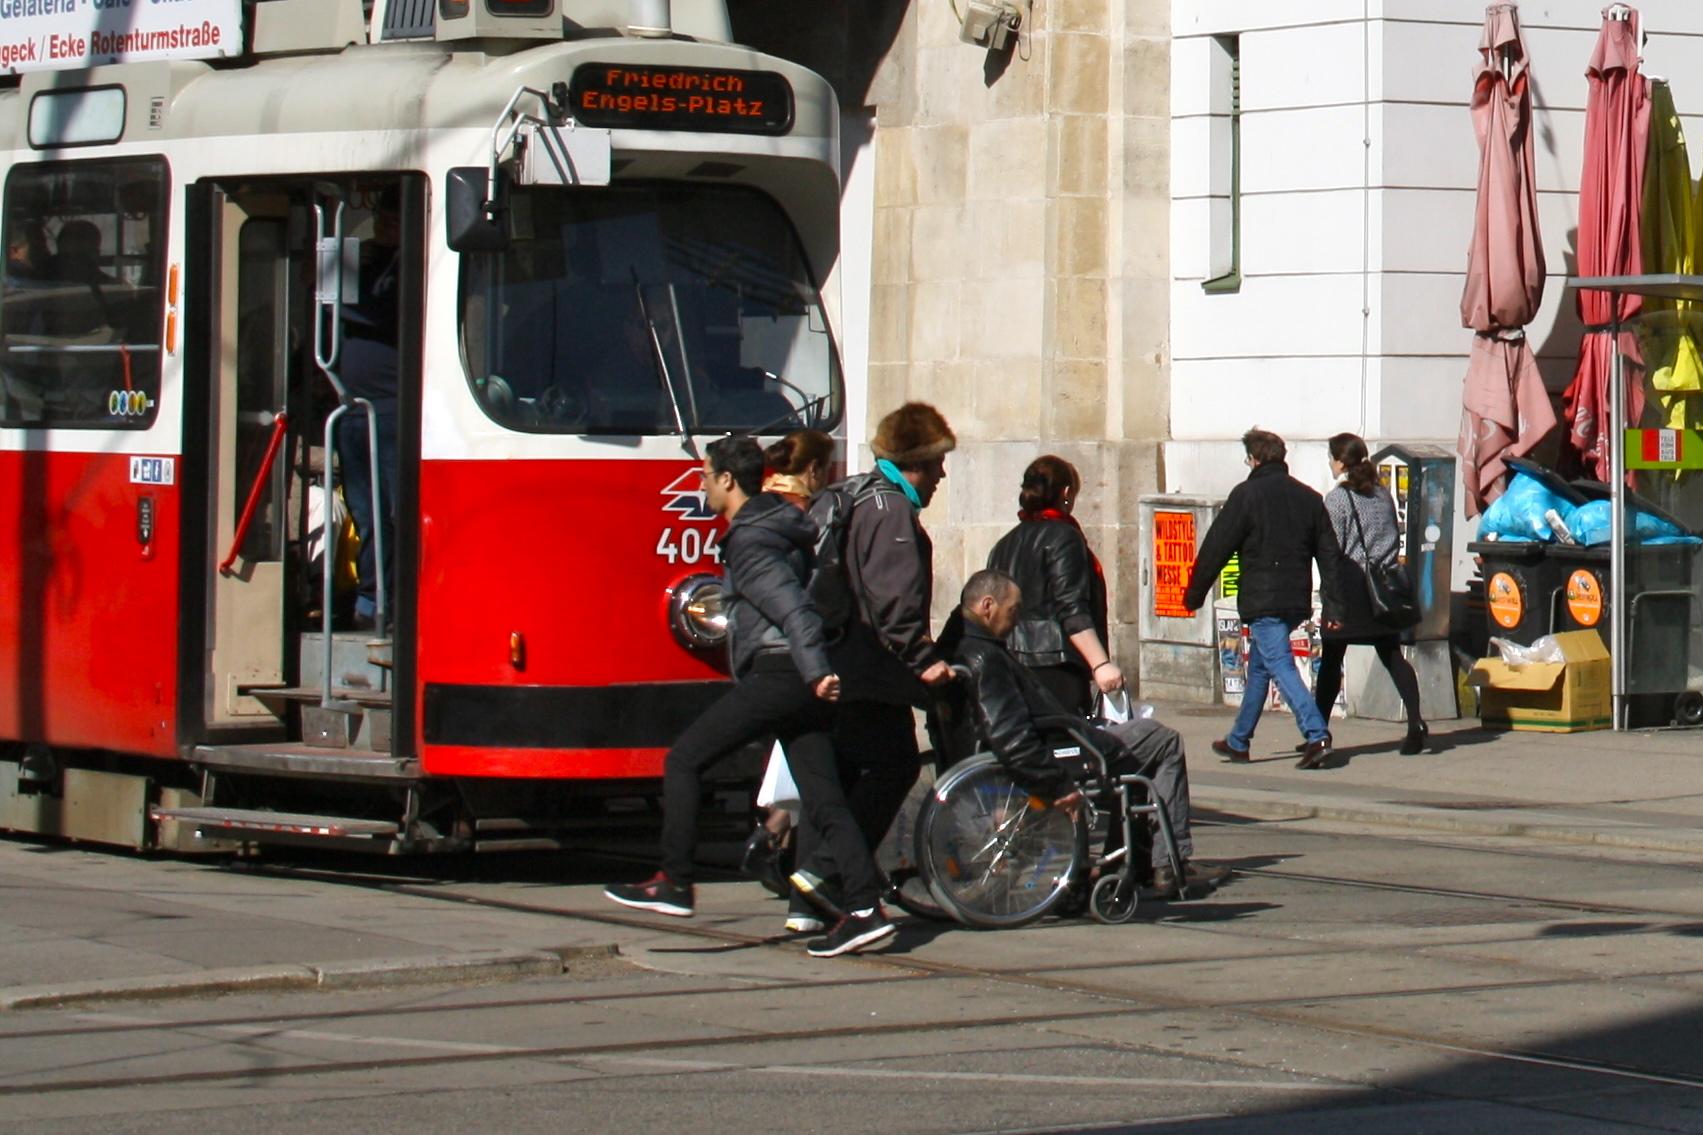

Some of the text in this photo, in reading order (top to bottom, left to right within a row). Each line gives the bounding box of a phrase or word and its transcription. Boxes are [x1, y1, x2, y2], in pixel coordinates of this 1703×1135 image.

[0, 36, 37, 65] geck
[49, 33, 86, 59] Ecke
[90, 20, 221, 56] Rotenturmstraße
[606, 69, 744, 93] Friedrich
[582, 91, 765, 116] Engels-Platz
[1156, 519, 1194, 541] WILDSTYLE
[656, 528, 727, 564] 404
[1164, 541, 1194, 563] TATTOO
[1156, 564, 1181, 585] MESSE
